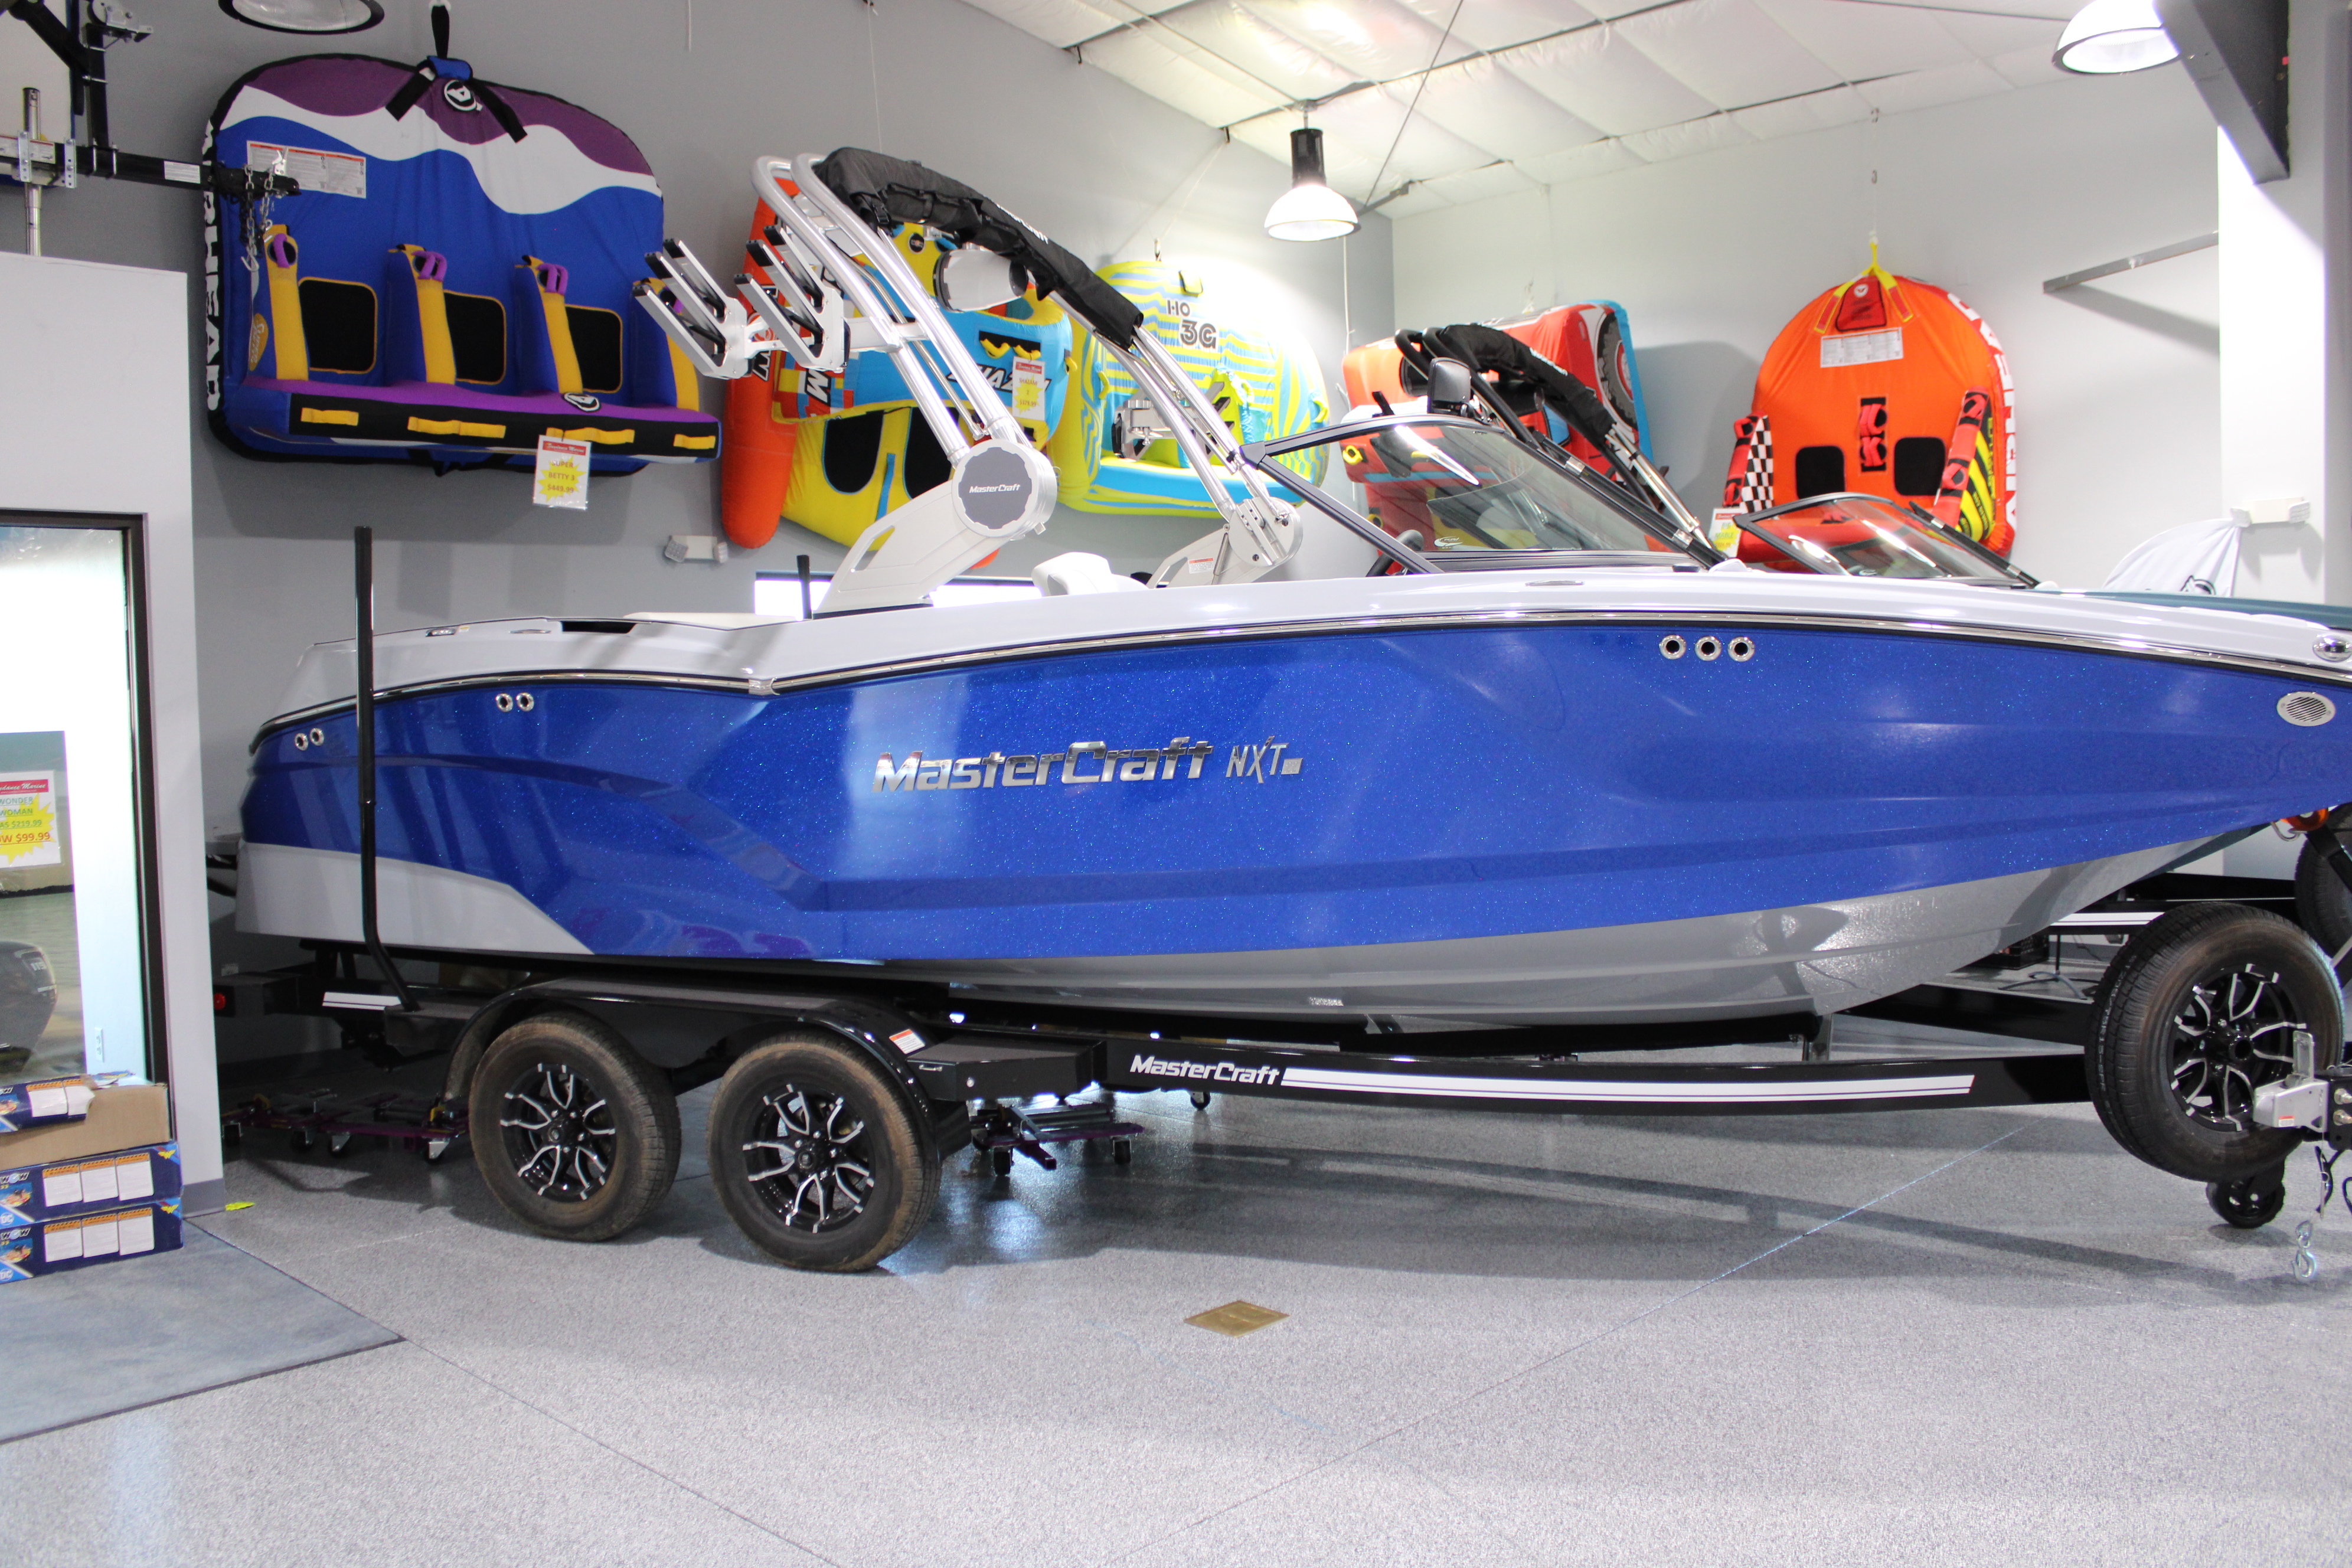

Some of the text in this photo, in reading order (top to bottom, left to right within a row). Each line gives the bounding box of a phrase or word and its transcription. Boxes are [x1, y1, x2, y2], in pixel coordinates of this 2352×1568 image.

[202, 115, 220, 412] ARHEAD
[1181, 319, 1216, 349] 3G
[1947, 293, 2017, 531] AIRHEAD
[548, 472, 569, 480] BETTY
[547, 484, 574, 493] $449.99
[969, 484, 1020, 494] MasterCraft
[872, 736, 1289, 792] MasterCraft NXT
[0, 796, 33, 805] WONDER
[0, 808, 32, 816] WOMAN
[12, 819, 42, 828] $219.99
[0, 832, 51, 843] W $99.99
[1130, 1055, 1279, 1085] MasterCraft
